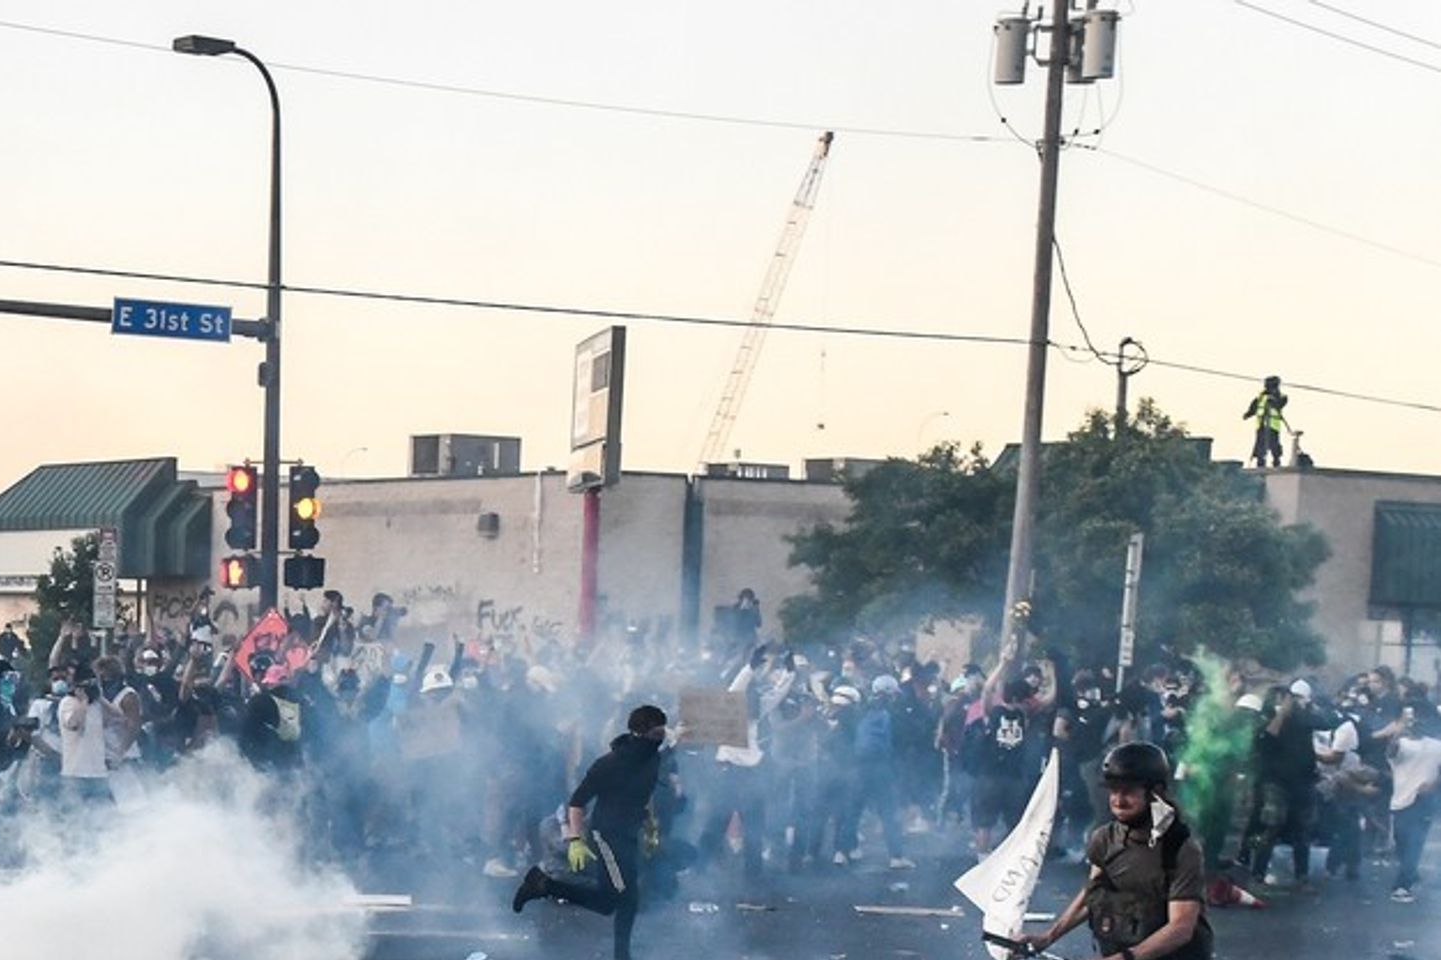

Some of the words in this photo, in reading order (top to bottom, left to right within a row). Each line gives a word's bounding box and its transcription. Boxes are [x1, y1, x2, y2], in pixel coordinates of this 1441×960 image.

[120, 306, 133, 326] E
[145, 309, 189, 332] 31st
[201, 313, 224, 333] St
